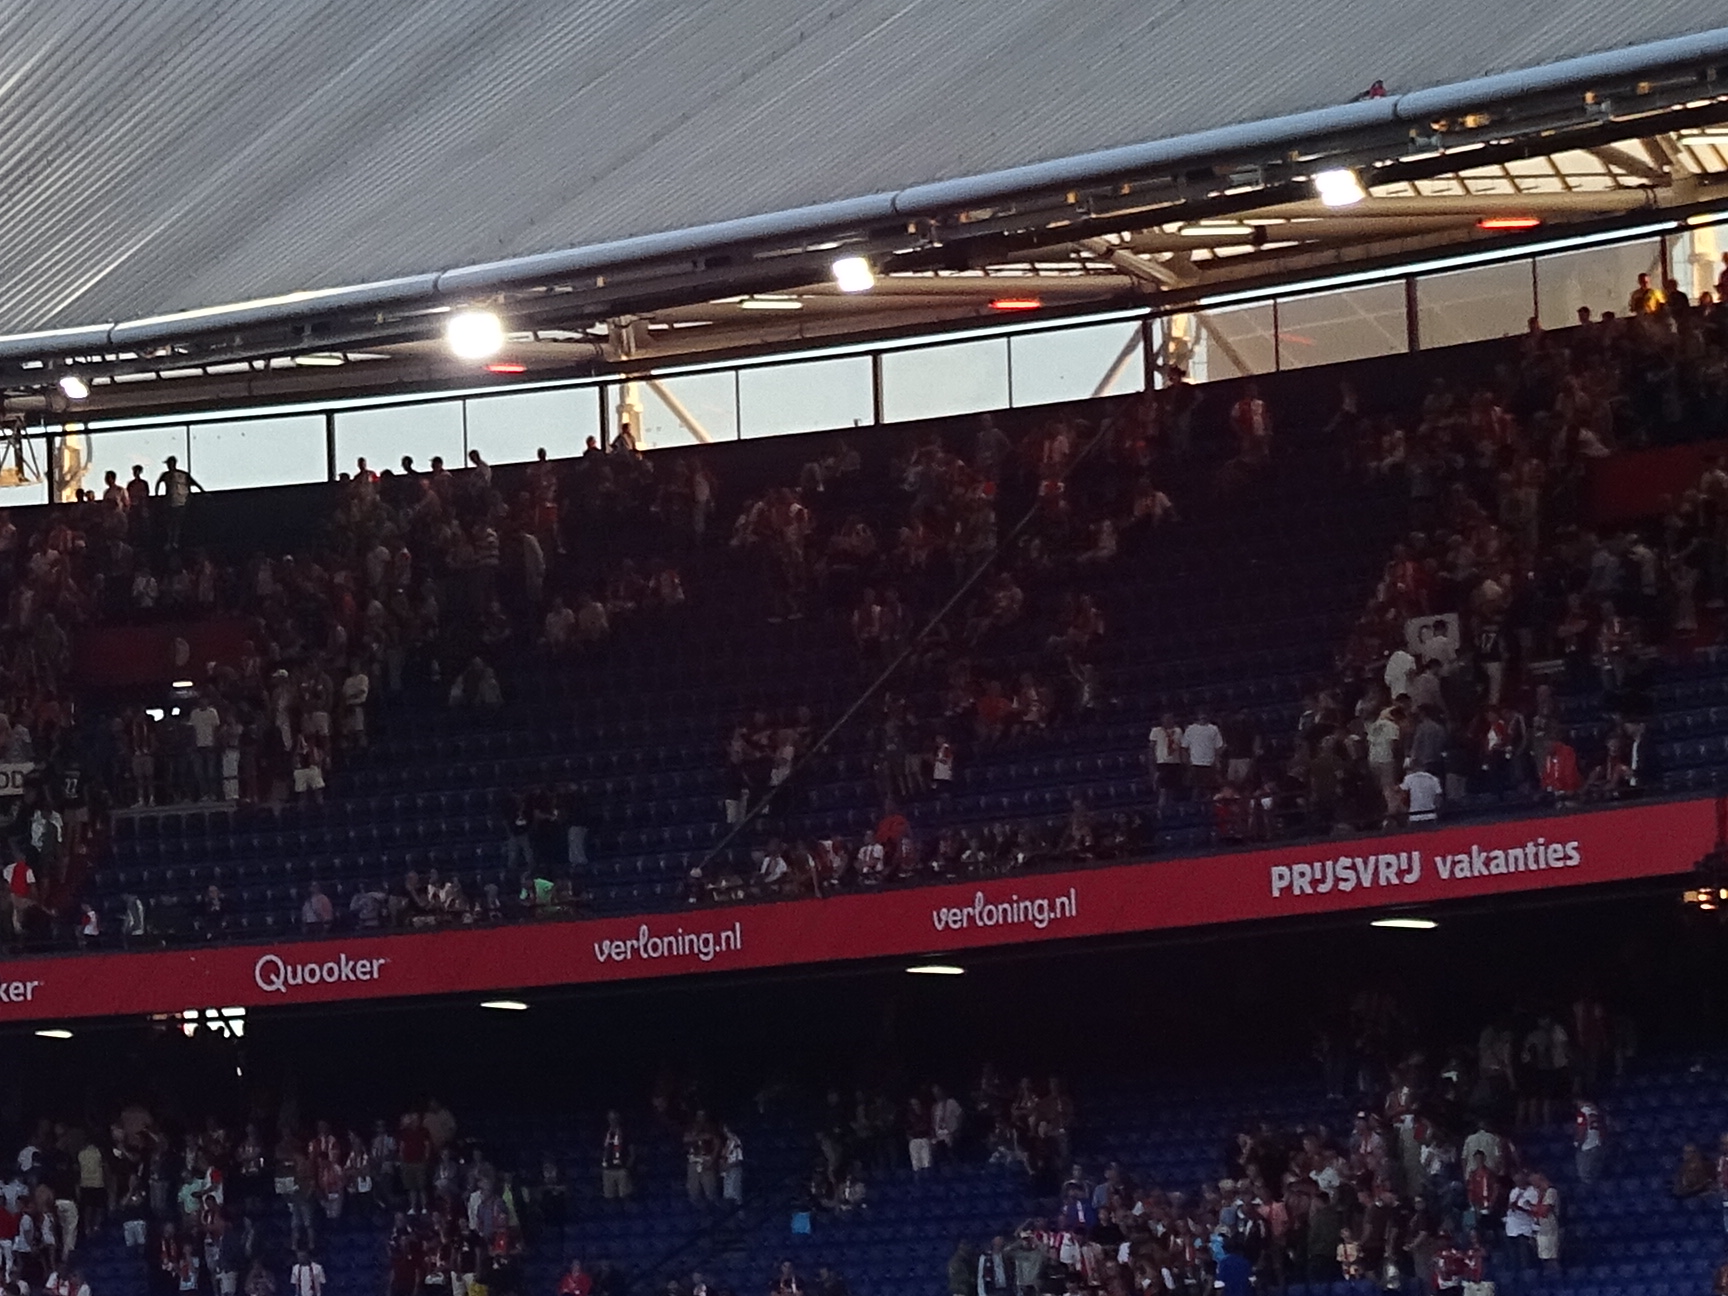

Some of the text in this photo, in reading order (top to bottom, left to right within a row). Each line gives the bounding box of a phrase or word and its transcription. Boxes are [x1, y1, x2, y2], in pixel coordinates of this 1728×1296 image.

[1271, 837, 1581, 897] PRIJSVRIJ vakanties
[932, 887, 1077, 931] verloning.nl
[594, 921, 741, 962] verloning.nl
[254, 953, 386, 993] Quooker
